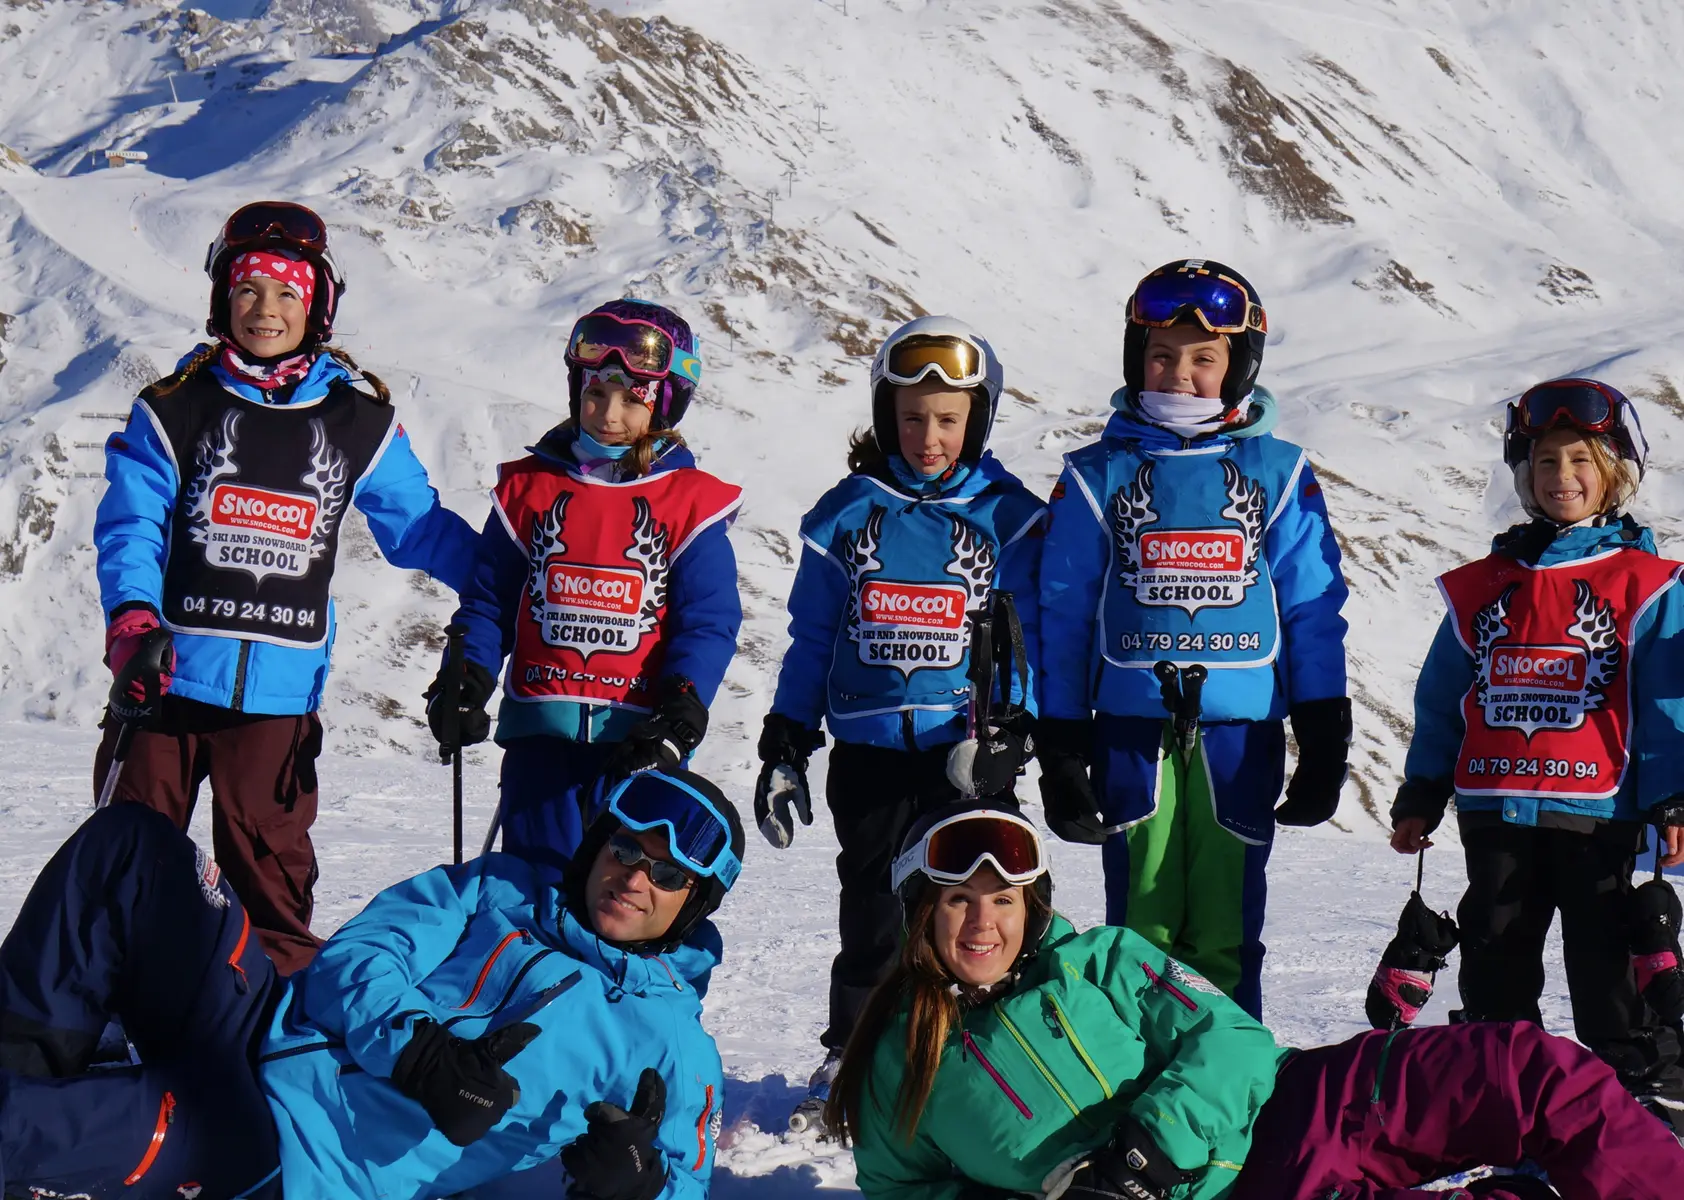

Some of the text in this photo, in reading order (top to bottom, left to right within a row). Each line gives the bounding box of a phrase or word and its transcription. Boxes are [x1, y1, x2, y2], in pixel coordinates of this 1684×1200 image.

[219, 493, 308, 530] SNOCOOL
[231, 517, 296, 535] WWW.SNOCOOL.COM
[212, 533, 307, 552] SKI AND SNOWBOARD
[1146, 540, 1236, 562] SNOCOOL
[219, 546, 298, 571] SCHOOL
[551, 572, 634, 604] SNOCOOL
[1141, 575, 1156, 583] SKI
[1180, 575, 1241, 583] SNOWBOARD
[1149, 586, 1233, 600] SCHOOL
[184, 596, 315, 627] 04 79 24 30 94
[865, 590, 956, 618] SNOCOOL
[560, 613, 577, 622] AND
[579, 614, 635, 628] SNOWBOARD
[876, 613, 943, 625] WWW.SNOCOOL.COM
[551, 625, 627, 647] SCHOOL
[862, 631, 959, 642] SKI AND SNOWBOARD
[1122, 634, 1260, 650] 04 79 24 30 94
[869, 644, 950, 661] SCHOOL
[1495, 655, 1577, 681] SNOCOOL
[1501, 694, 1518, 702] AND
[1521, 693, 1580, 704] SNOWBOARD
[1493, 706, 1572, 723] SCHOOL
[1468, 758, 1598, 778] 04 79 24 30 94
